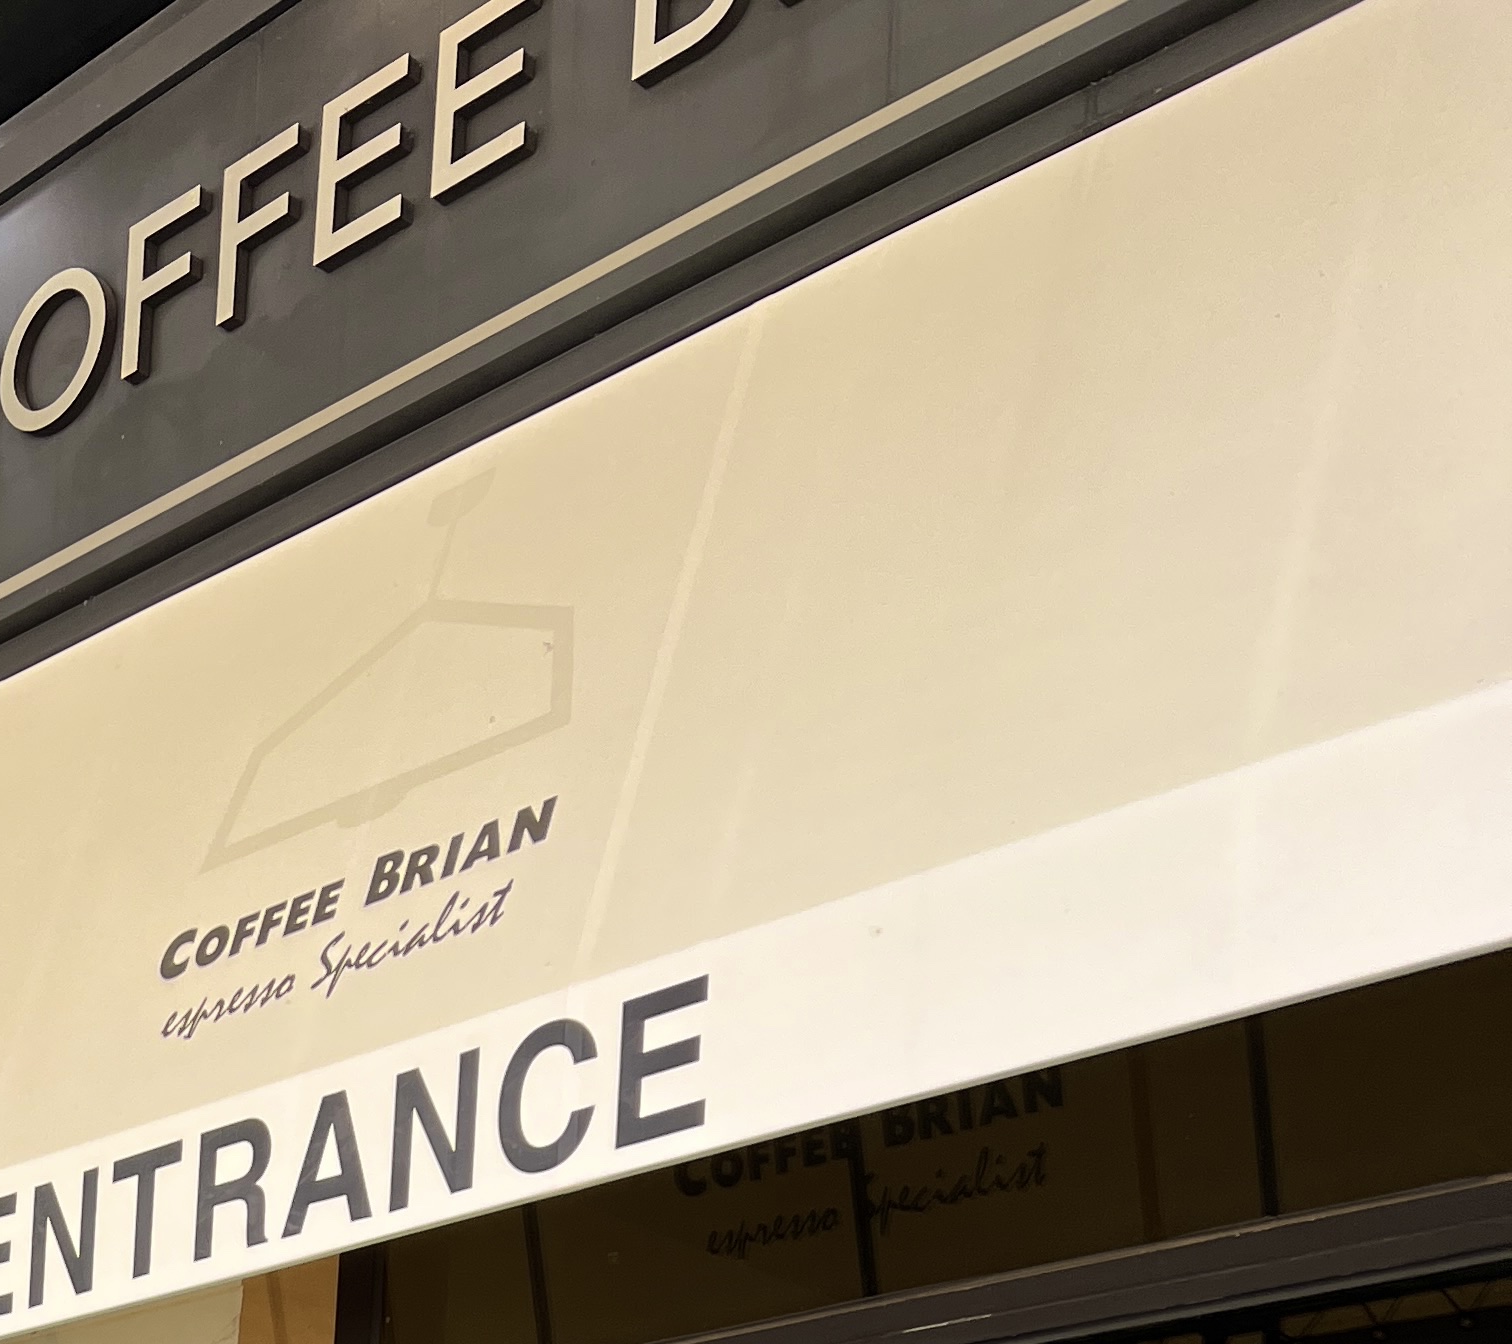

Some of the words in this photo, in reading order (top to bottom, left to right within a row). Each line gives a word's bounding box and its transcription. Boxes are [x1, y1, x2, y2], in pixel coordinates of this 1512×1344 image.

[159, 878, 345, 981] COFFEE
[362, 796, 558, 909] BRIAN
[160, 973, 297, 1041] espresso
[311, 880, 515, 996] Specialist
[880, 1067, 1065, 1149] BRIAN
[706, 1206, 840, 1260] espresso
